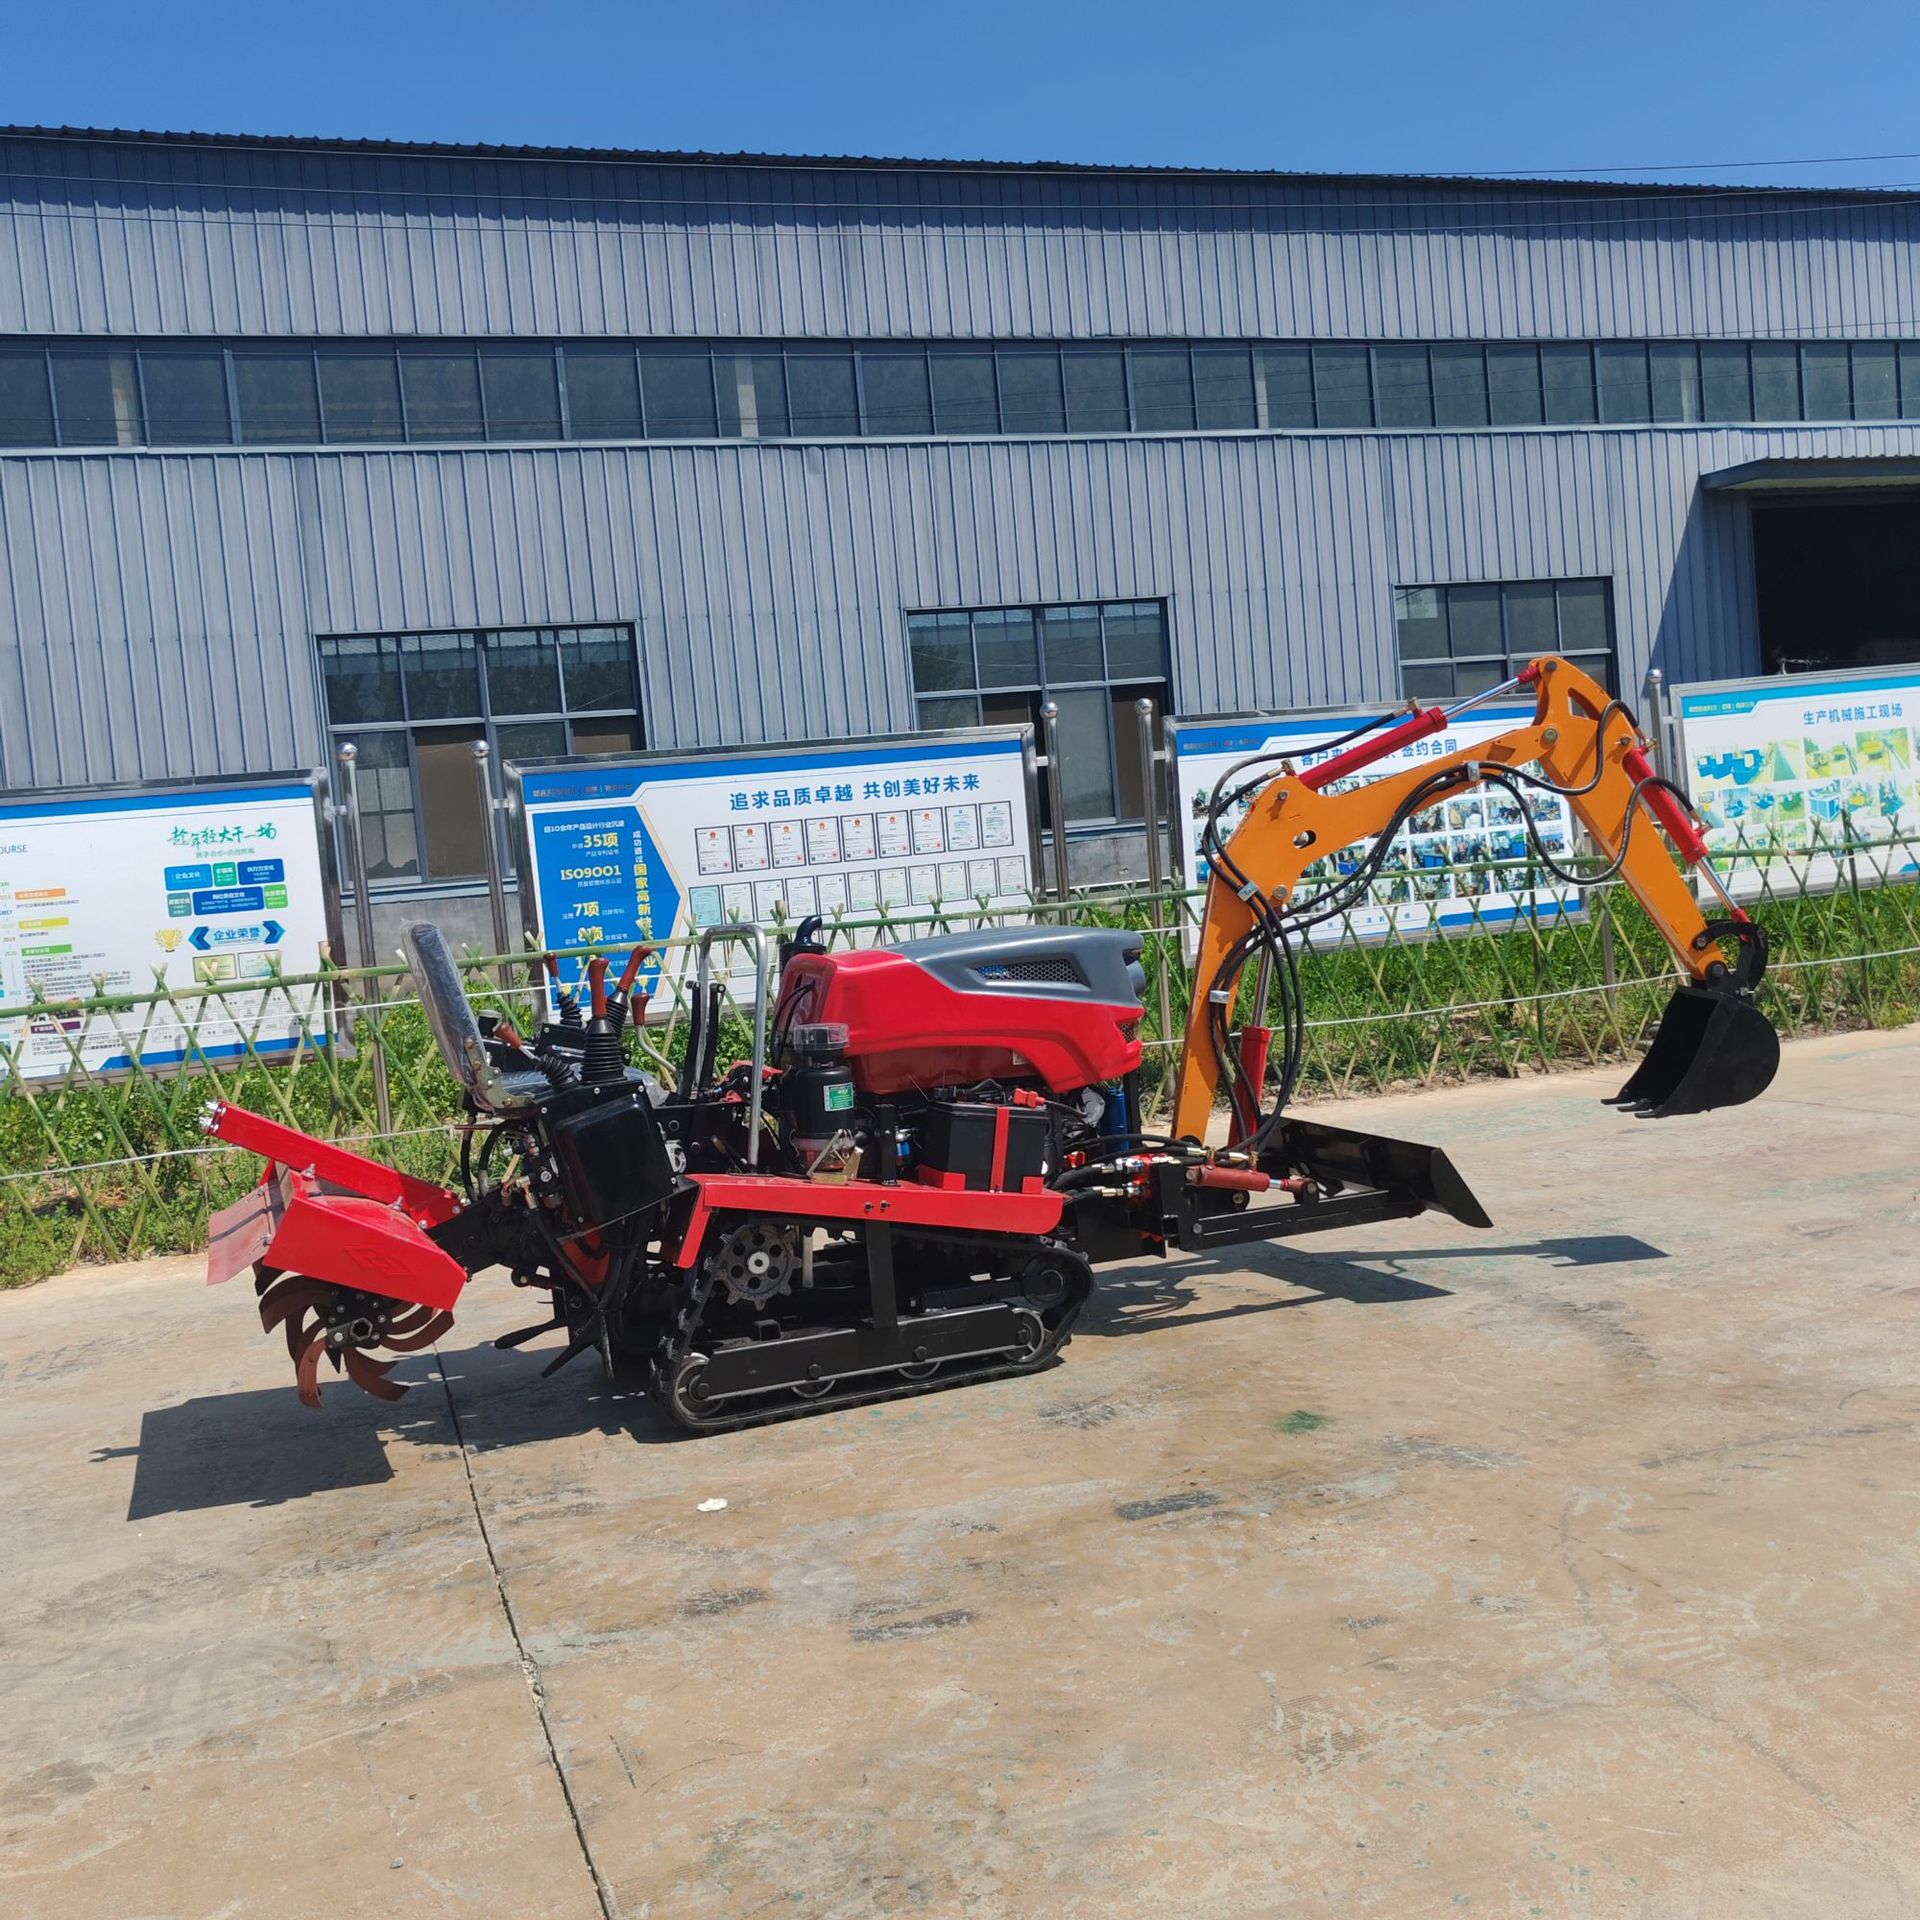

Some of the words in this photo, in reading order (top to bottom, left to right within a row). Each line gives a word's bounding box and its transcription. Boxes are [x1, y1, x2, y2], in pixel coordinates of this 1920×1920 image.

[1803, 703, 1903, 725] 生产机械施工现场
[1301, 738, 1457, 767] 客户来、签约合同
[730, 784, 853, 811] 追求品质卓越
[863, 773, 980, 799] 共创美好未来
[560, 864, 622, 881] ISO9001
[213, 926, 260, 941] 企业荣誉
